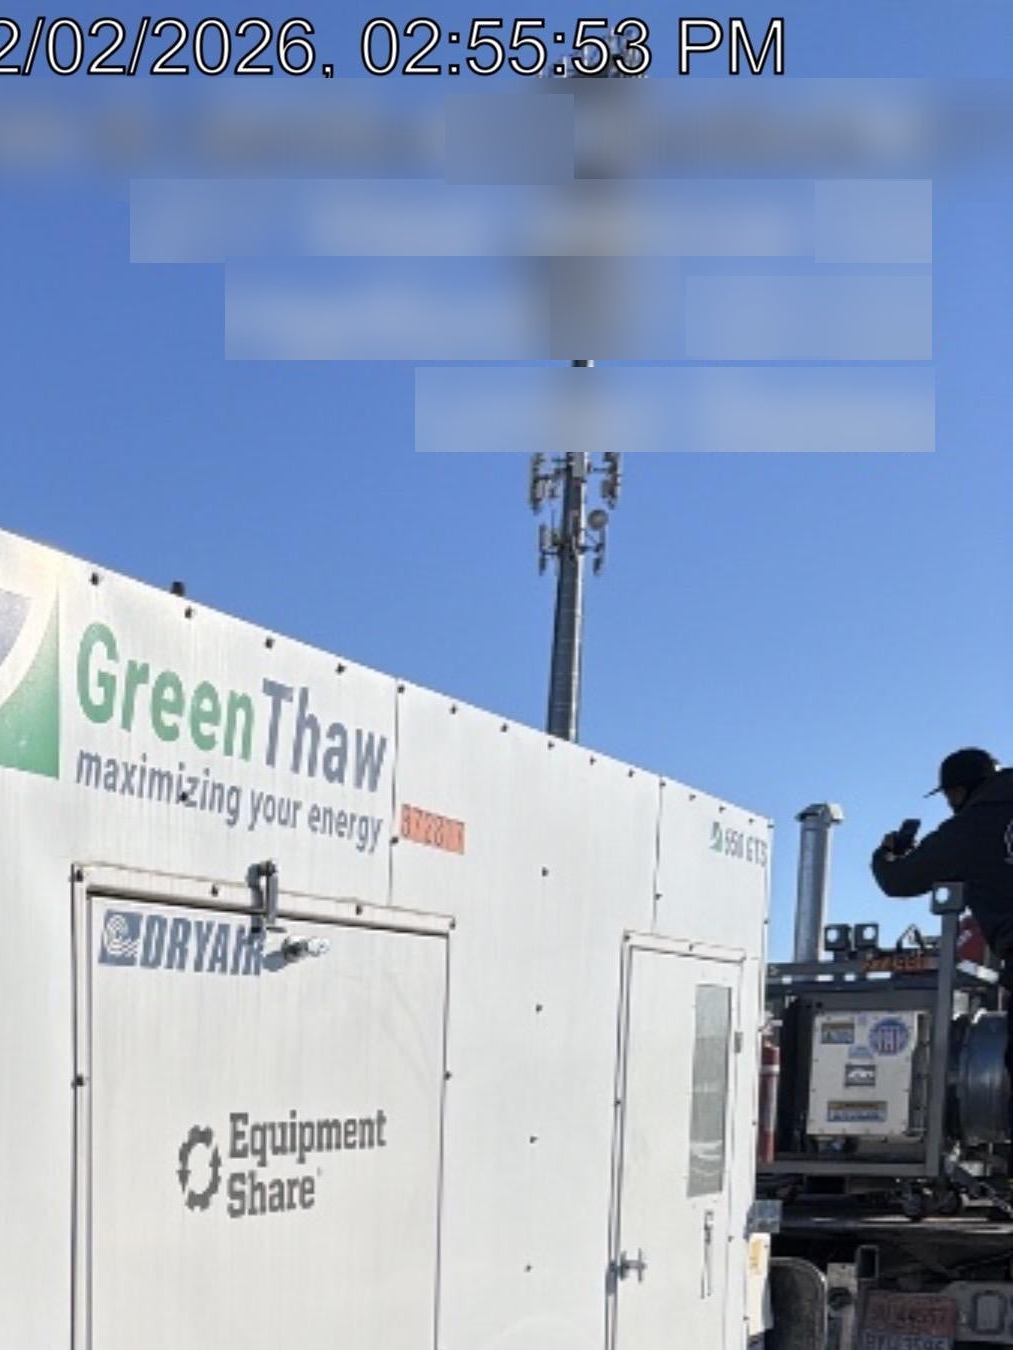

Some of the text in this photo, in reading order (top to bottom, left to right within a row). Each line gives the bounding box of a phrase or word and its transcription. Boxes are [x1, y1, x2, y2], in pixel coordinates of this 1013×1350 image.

[76, 749, 384, 854] maximizing your energy
[140, 914, 264, 976] DRYAIR
[228, 1109, 387, 1167] Equipment
[227, 1170, 316, 1219] Share
